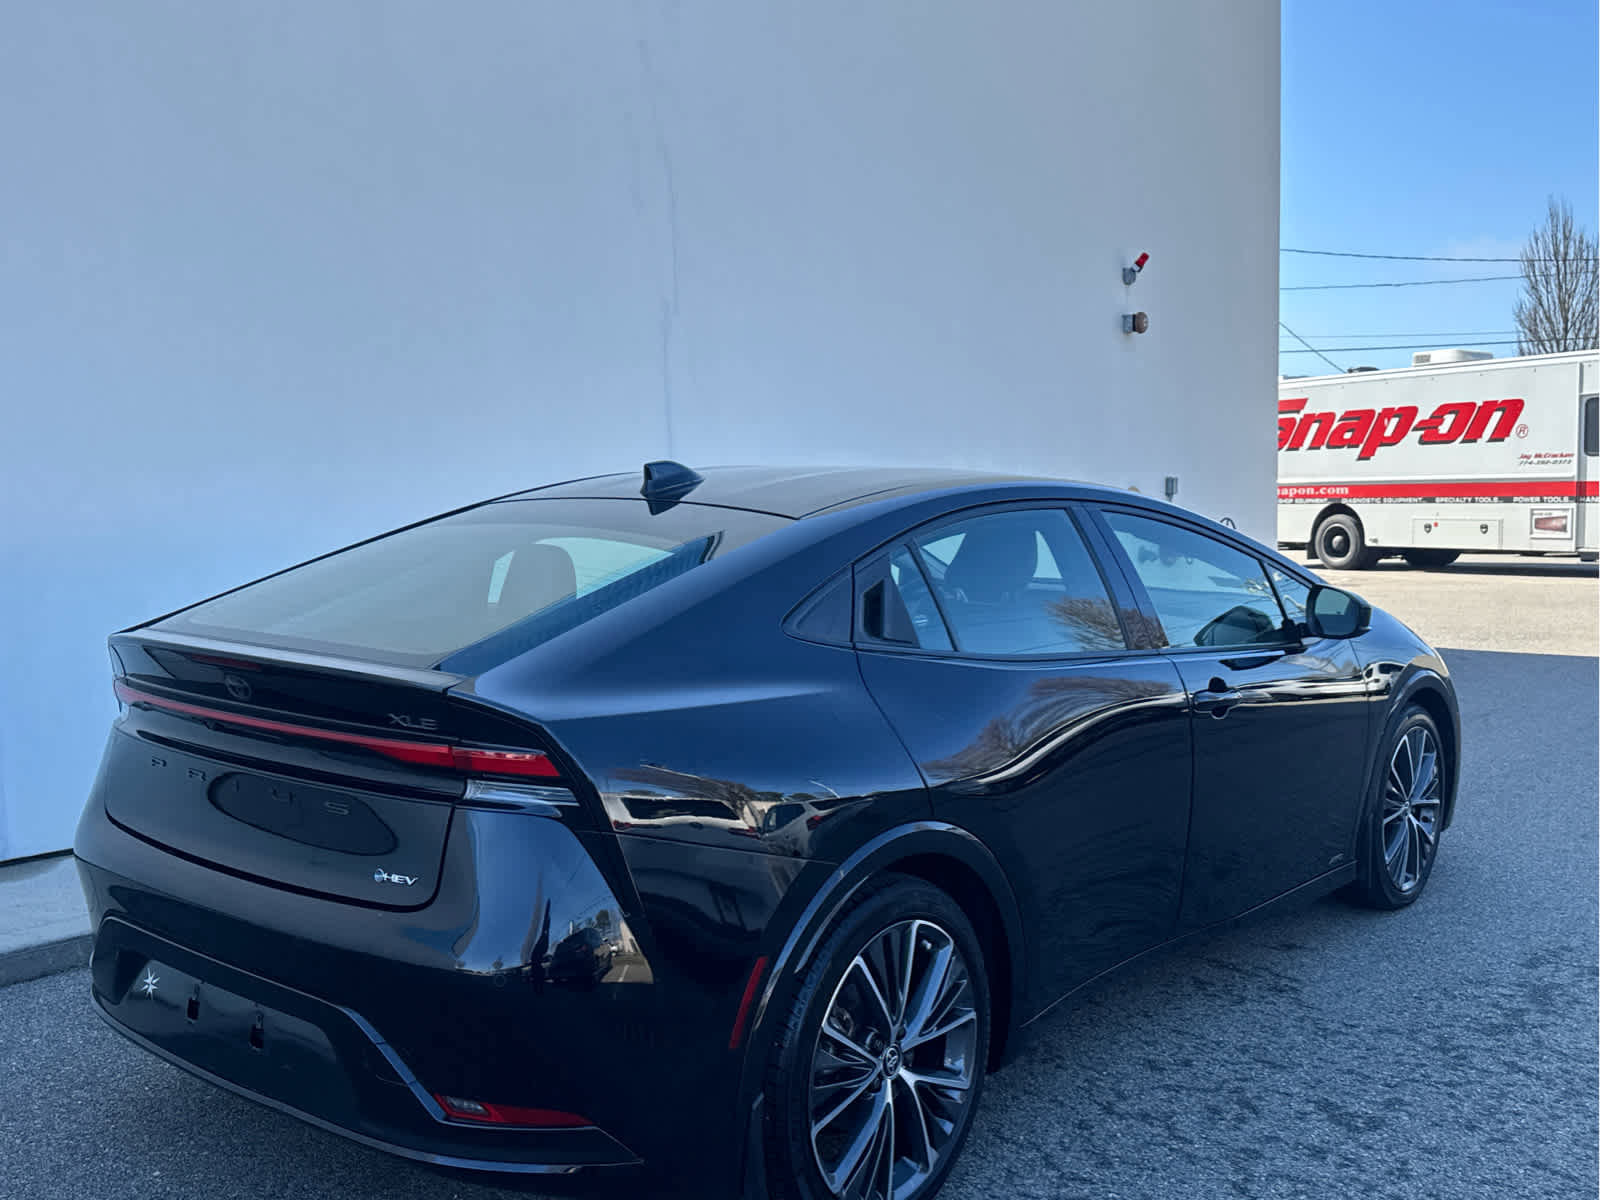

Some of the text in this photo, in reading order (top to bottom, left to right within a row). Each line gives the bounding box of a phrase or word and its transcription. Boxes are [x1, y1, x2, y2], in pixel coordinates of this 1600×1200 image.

[386, 713, 438, 730] XLE
[151, 755, 350, 816] PRIUS
[384, 872, 418, 886] HEV
